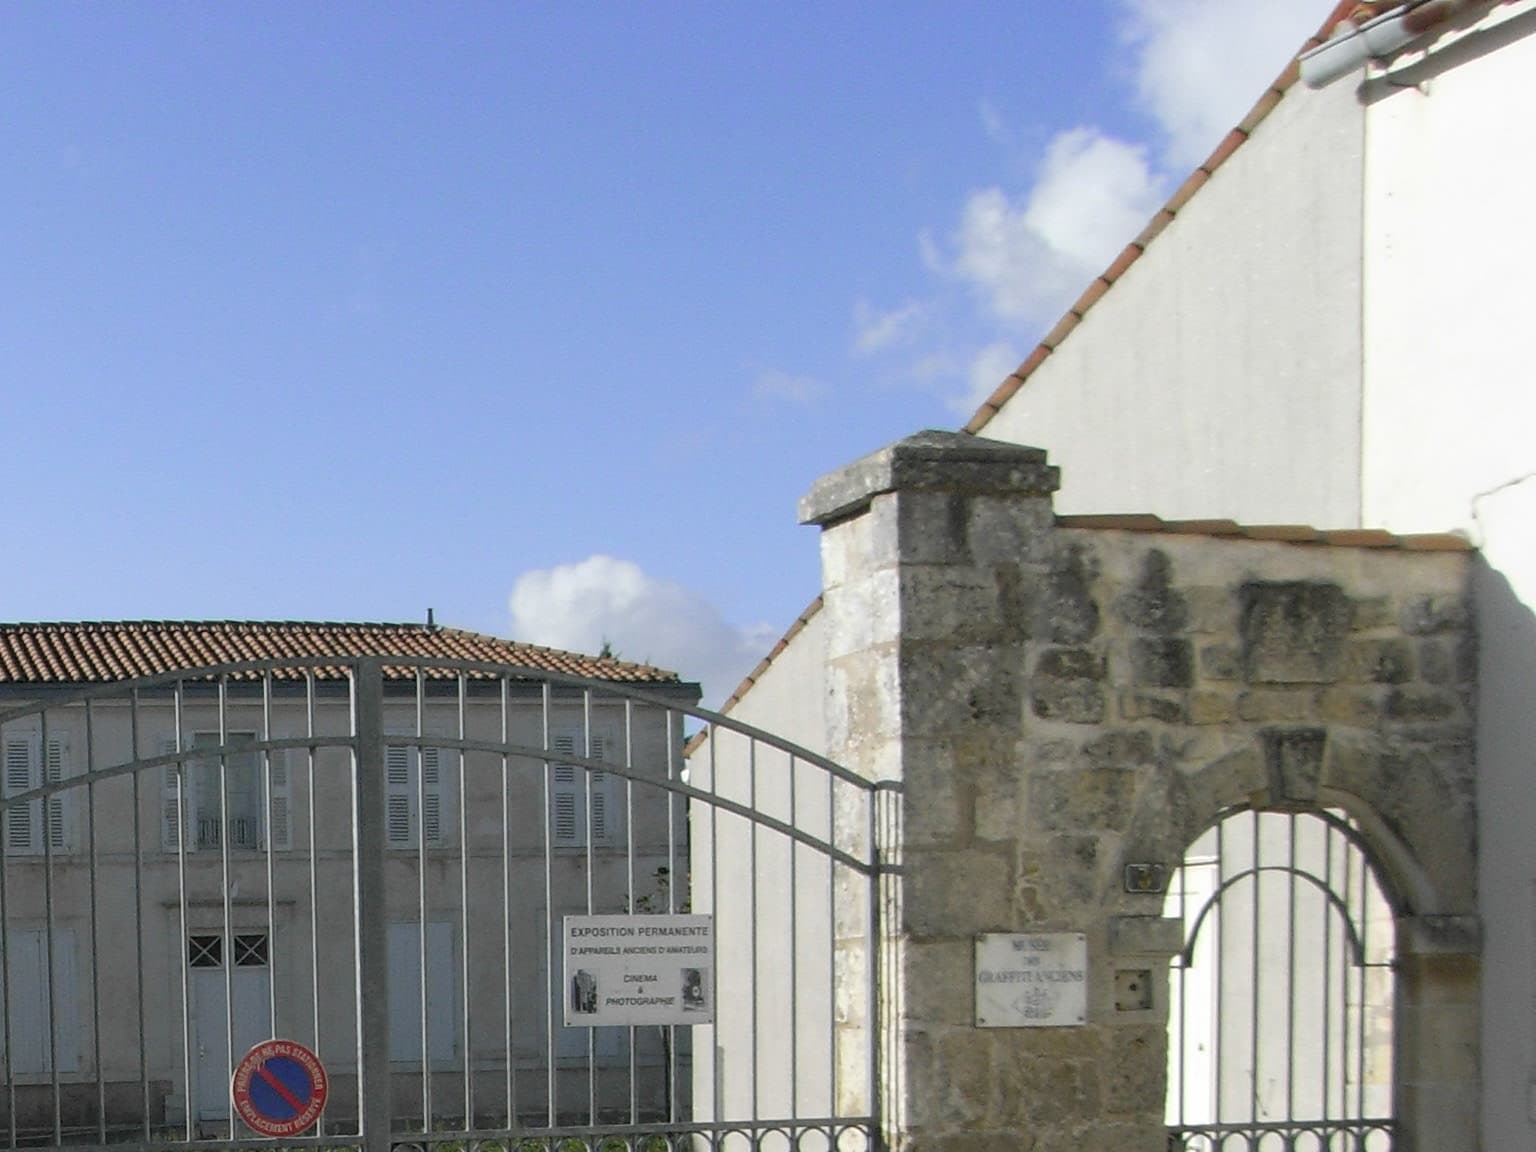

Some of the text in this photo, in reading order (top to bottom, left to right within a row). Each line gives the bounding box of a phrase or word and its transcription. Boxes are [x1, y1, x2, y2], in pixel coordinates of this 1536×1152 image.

[571, 926, 709, 938] EXPOSITION PERMANENTE
[605, 996, 676, 1007] PHOTOGRAPHIE
[275, 1044, 291, 1054] PAS
